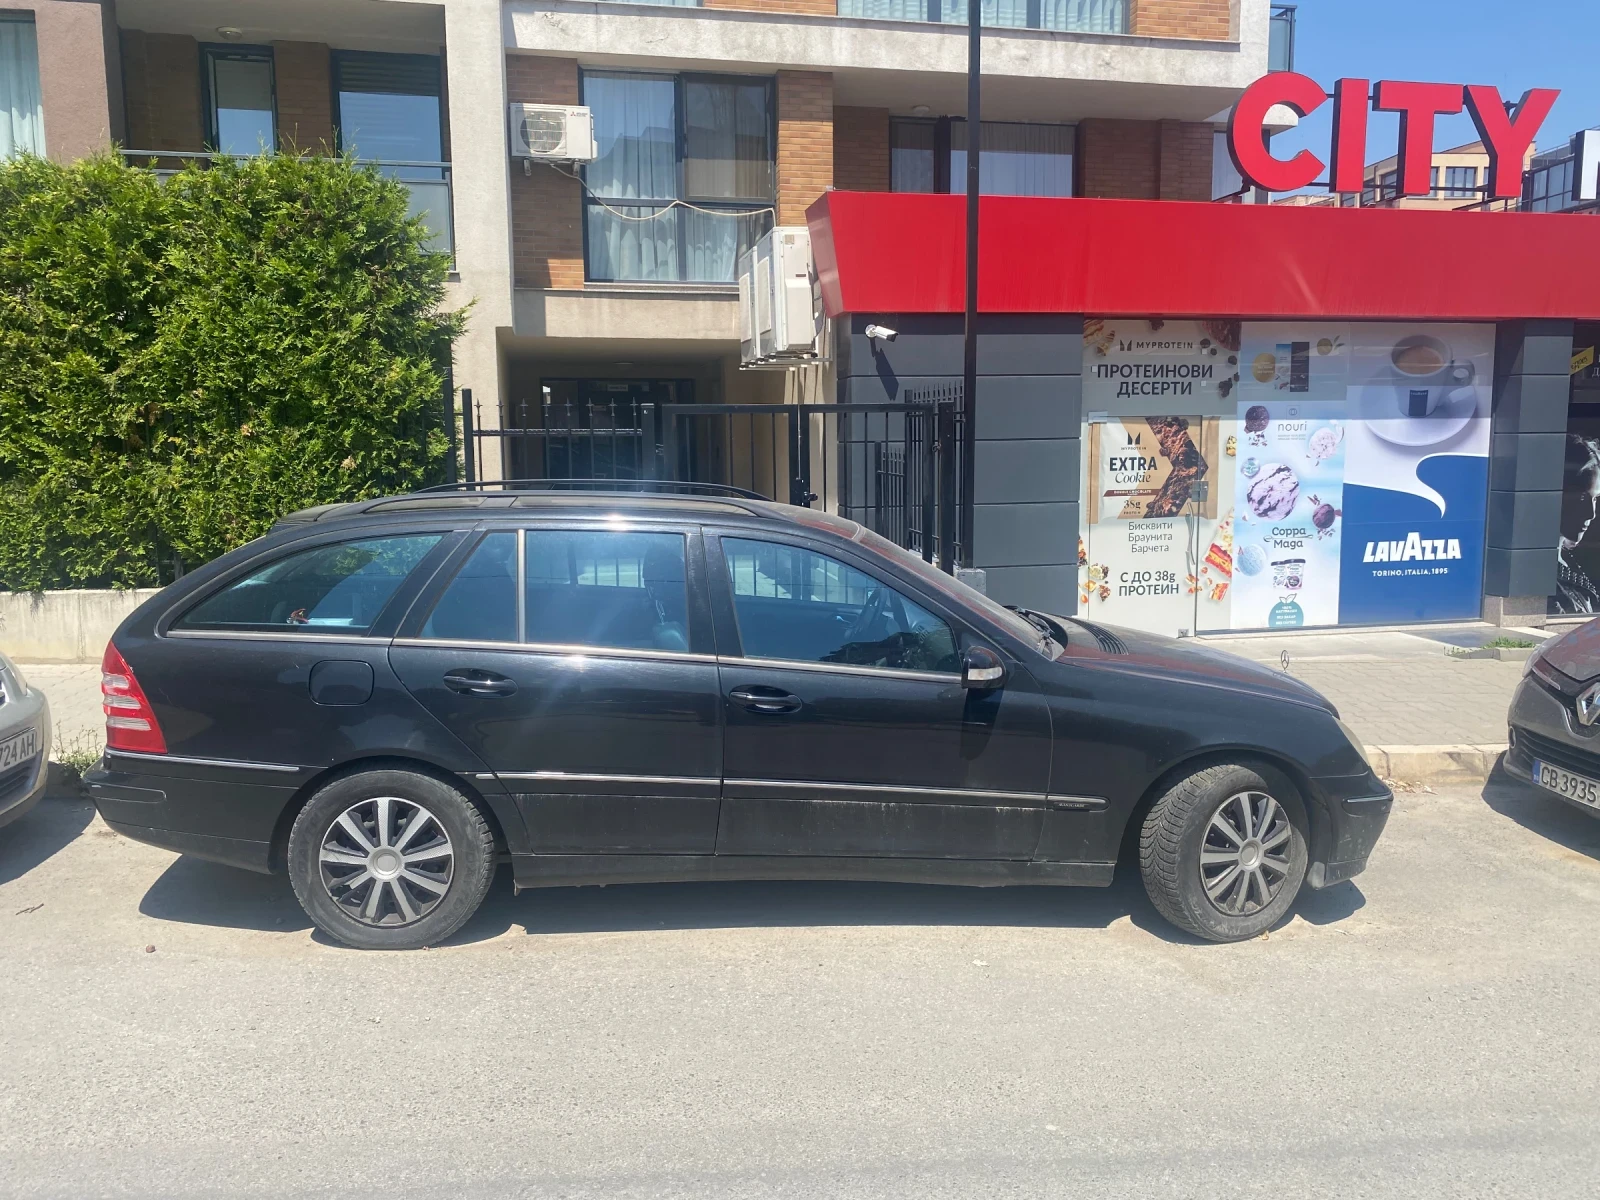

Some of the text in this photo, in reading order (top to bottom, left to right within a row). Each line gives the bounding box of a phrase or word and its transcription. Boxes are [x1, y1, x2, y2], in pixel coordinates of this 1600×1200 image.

[1227, 71, 1561, 198] CITY
[1136, 341, 1193, 349] MYPROTEIN
[1097, 364, 1213, 379] ПРОТЕИНОВИ
[1116, 381, 1192, 398] ДЕСЕРТИ
[1277, 420, 1307, 431] nouri
[1109, 456, 1158, 472] EXTRA
[1115, 472, 1151, 484] Cookie
[1123, 499, 1141, 510] 38g
[1128, 522, 1173, 531] Бисквити
[1271, 526, 1306, 537] Coppa
[1128, 533, 1173, 543] Браунита
[1131, 544, 1170, 553] Барчета
[1273, 539, 1304, 550] Maga
[1363, 532, 1461, 562] LAVAZZA
[1120, 570, 1176, 584] С ДО 38g
[1431, 567, 1448, 575] 1895
[1119, 584, 1179, 596] ПРОТЕИН
[20, 733, 34, 760] AH
[1541, 766, 1597, 803] CB 3935
